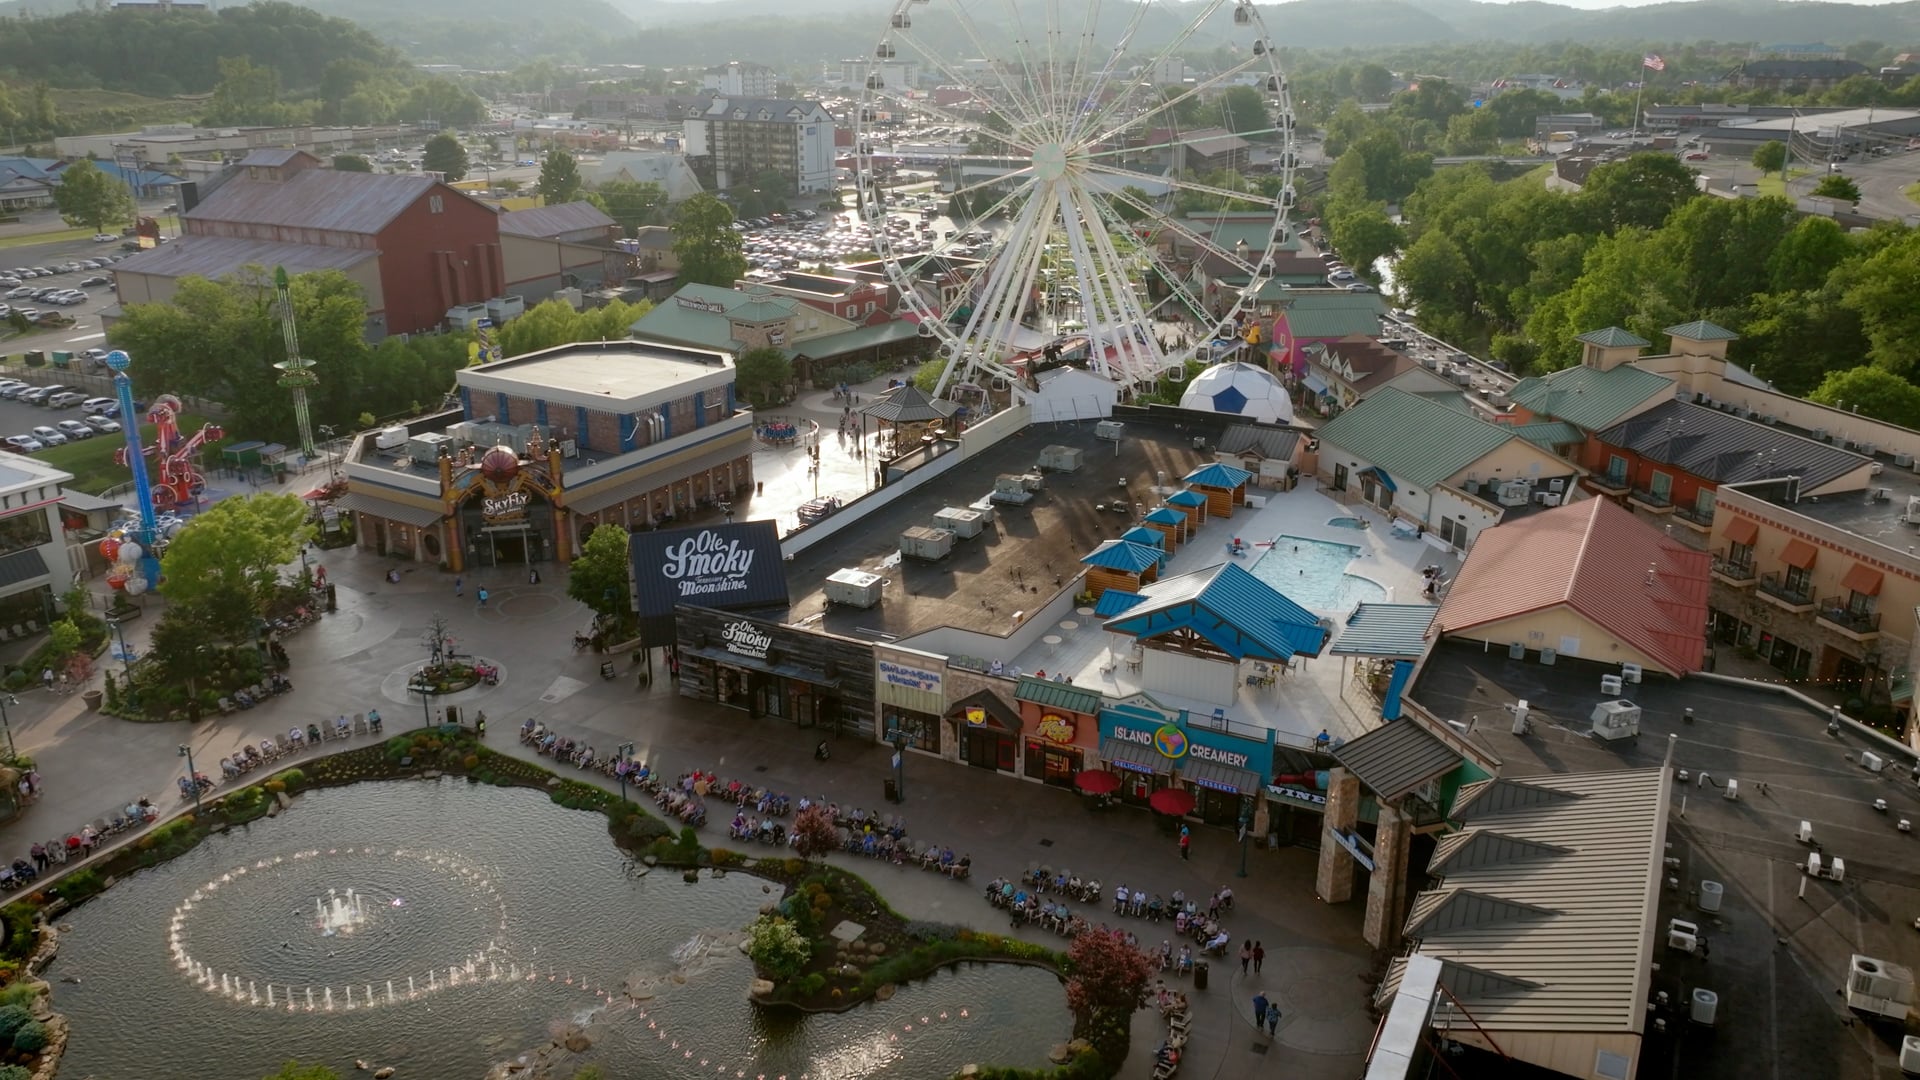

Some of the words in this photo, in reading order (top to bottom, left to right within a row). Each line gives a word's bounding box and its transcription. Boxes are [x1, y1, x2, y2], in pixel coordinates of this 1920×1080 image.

[697, 530, 728, 553] Ole
[662, 538, 755, 579] Smoky
[740, 620, 760, 635] Ole
[726, 642, 767, 659] Moonshine
[1114, 725, 1152, 745] ISLAND
[1189, 743, 1248, 768] CREAMERY
[1114, 760, 1152, 774] DELICIOUS
[1198, 779, 1238, 793] DESSERTS
[1266, 784, 1326, 804] WINE
